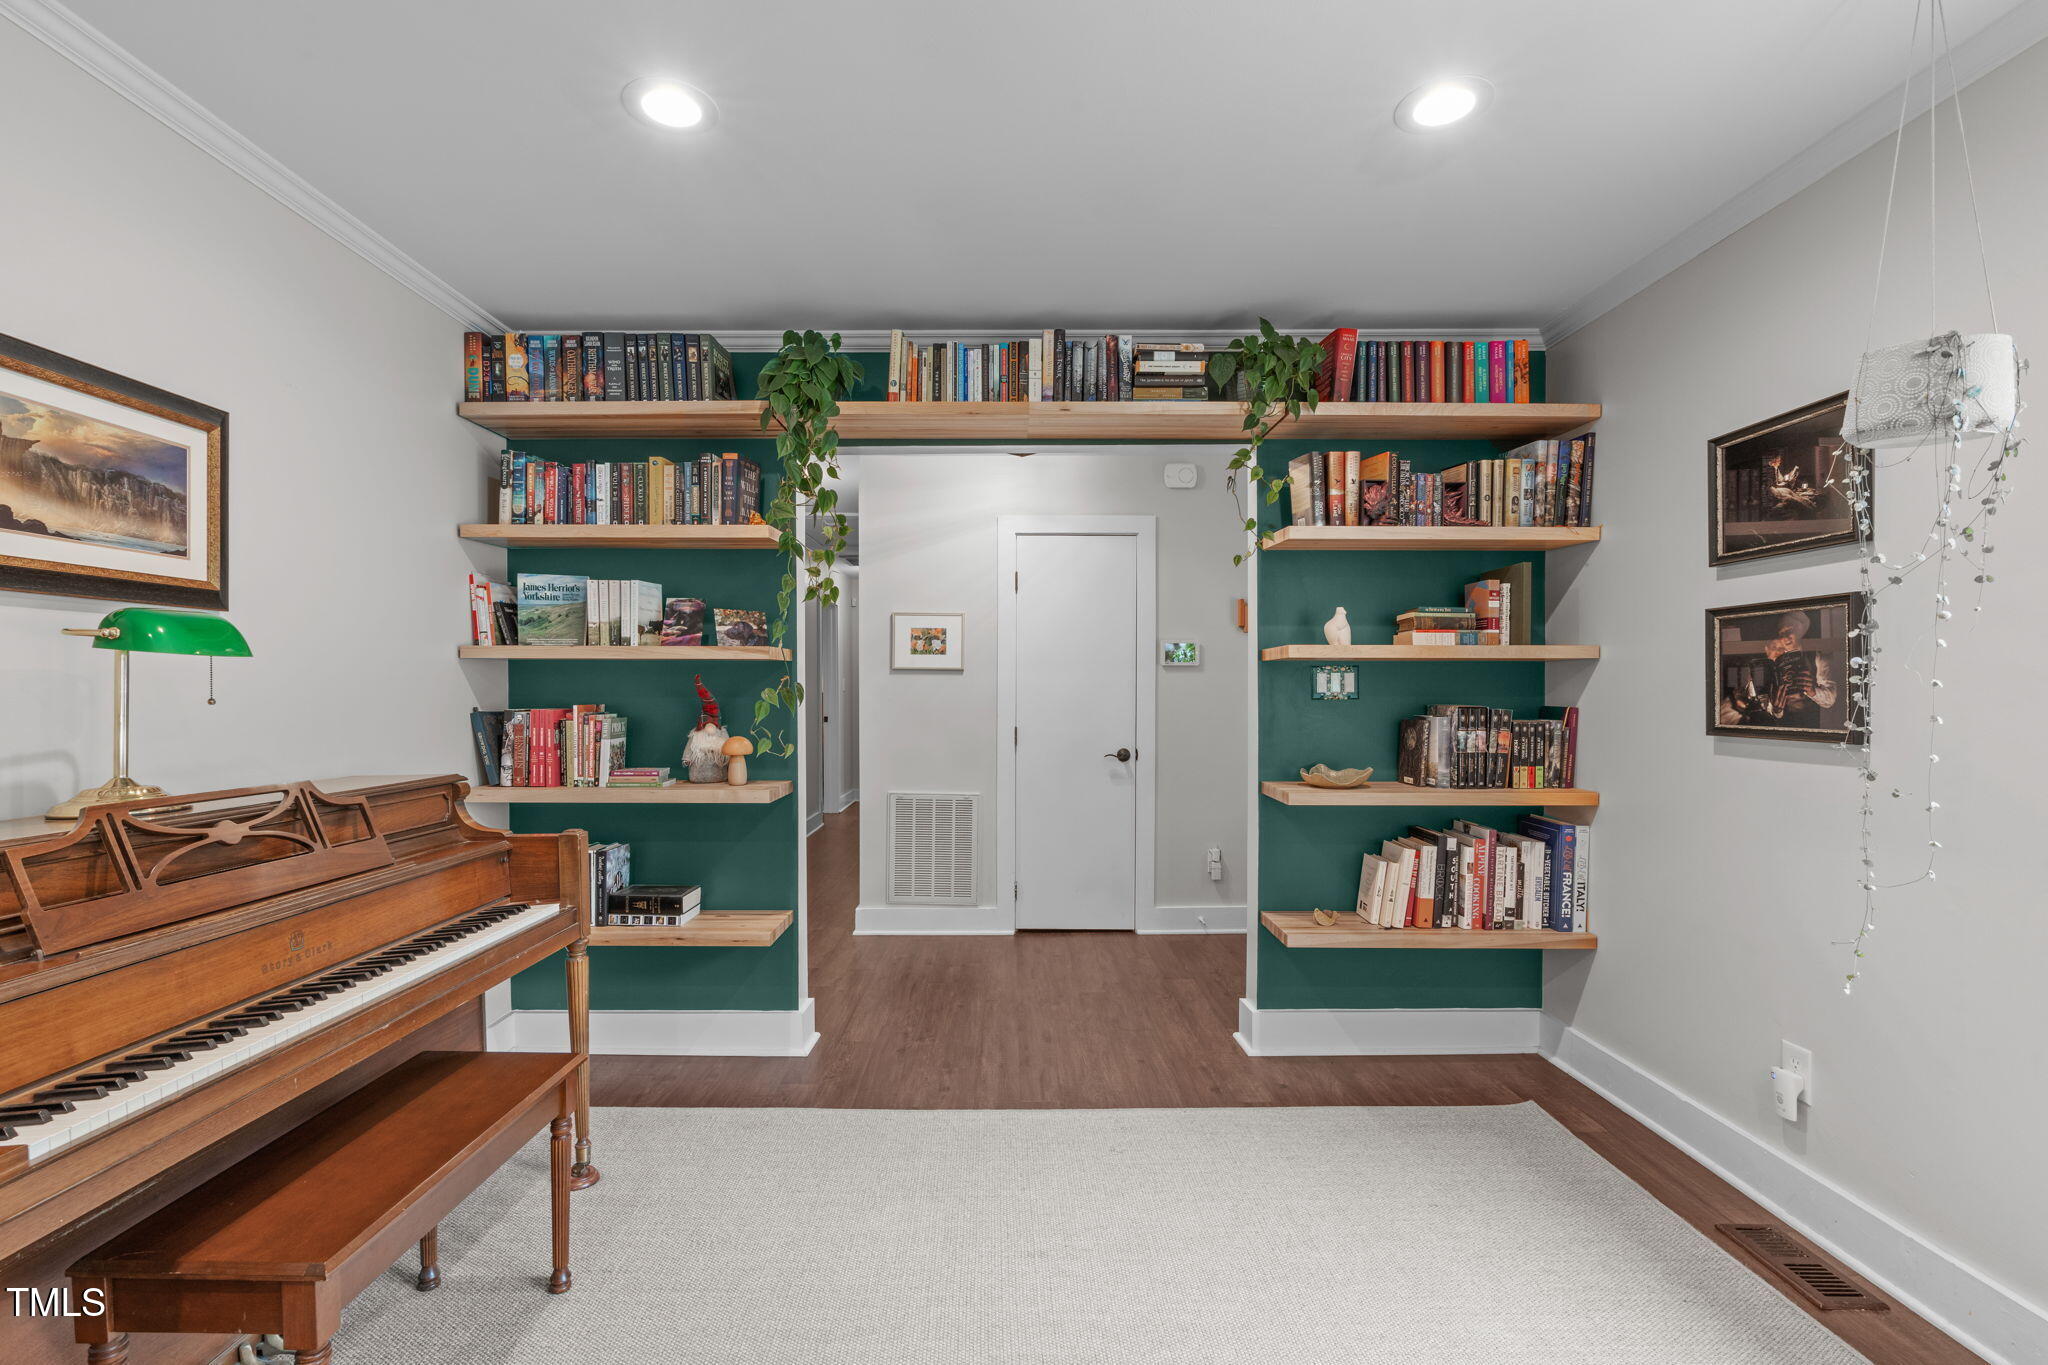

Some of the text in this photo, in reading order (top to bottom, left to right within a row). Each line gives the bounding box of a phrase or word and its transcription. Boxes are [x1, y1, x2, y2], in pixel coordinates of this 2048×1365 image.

[467, 367, 481, 398] DUNE
[567, 350, 577, 394] OATHBRINGER
[502, 454, 511, 489] Longbourn
[744, 468, 758, 480] THE
[744, 494, 756, 506] THE
[523, 592, 560, 602] Yorkshire
[524, 582, 580, 592] James Herriot's
[1448, 856, 1457, 900] SOUTH
[1494, 848, 1505, 922] TARTINE BREAD
[1472, 876, 1482, 920] COOKING
[1562, 872, 1572, 918] FRANCE!
[1576, 882, 1586, 912] ITALY!
[261, 941, 332, 974] Story & Clark
